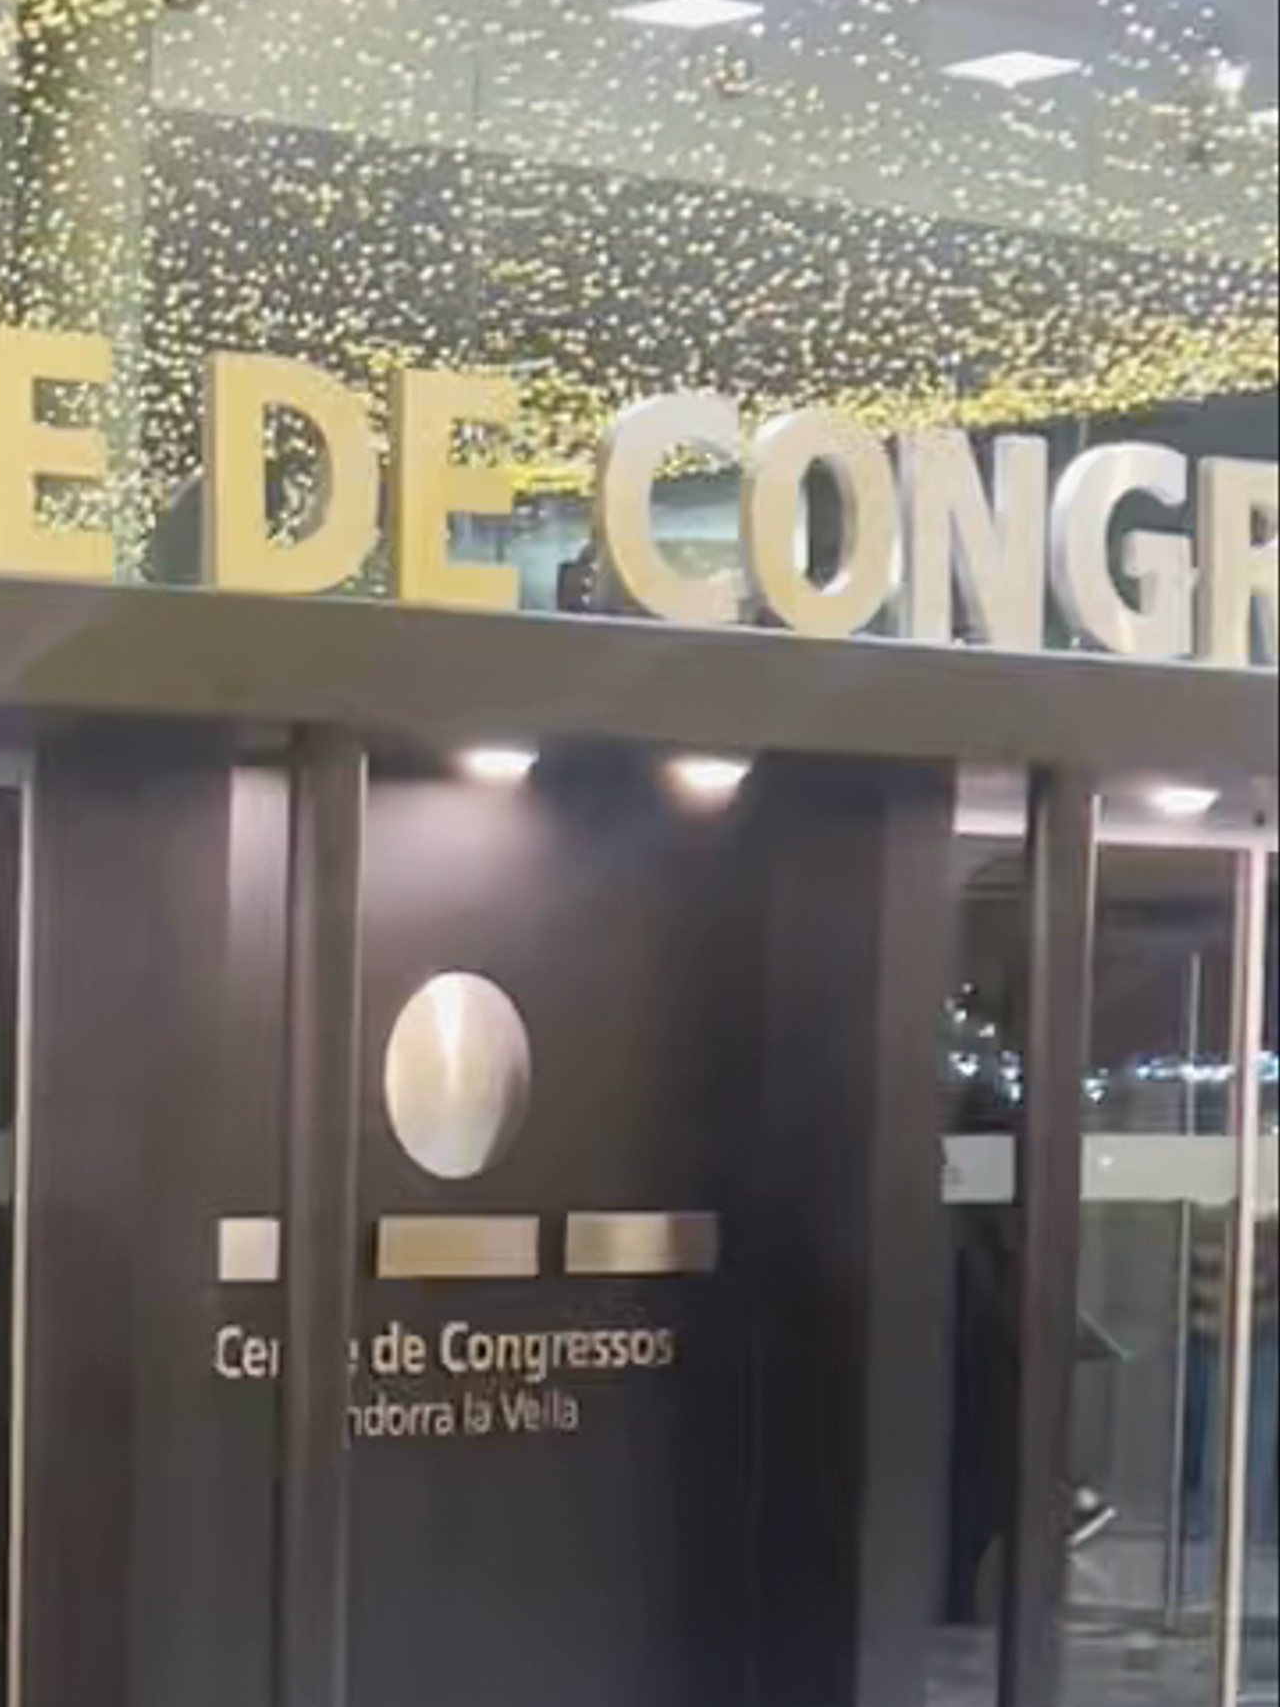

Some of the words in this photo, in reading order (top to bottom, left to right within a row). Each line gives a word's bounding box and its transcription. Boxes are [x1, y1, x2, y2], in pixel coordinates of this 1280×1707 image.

[202, 351, 521, 611] DE
[593, 391, 1278, 667] CONGR
[372, 1321, 426, 1374] de
[441, 1320, 674, 1383] Congressos
[346, 1393, 455, 1437] ndorra
[464, 1393, 492, 1434] la
